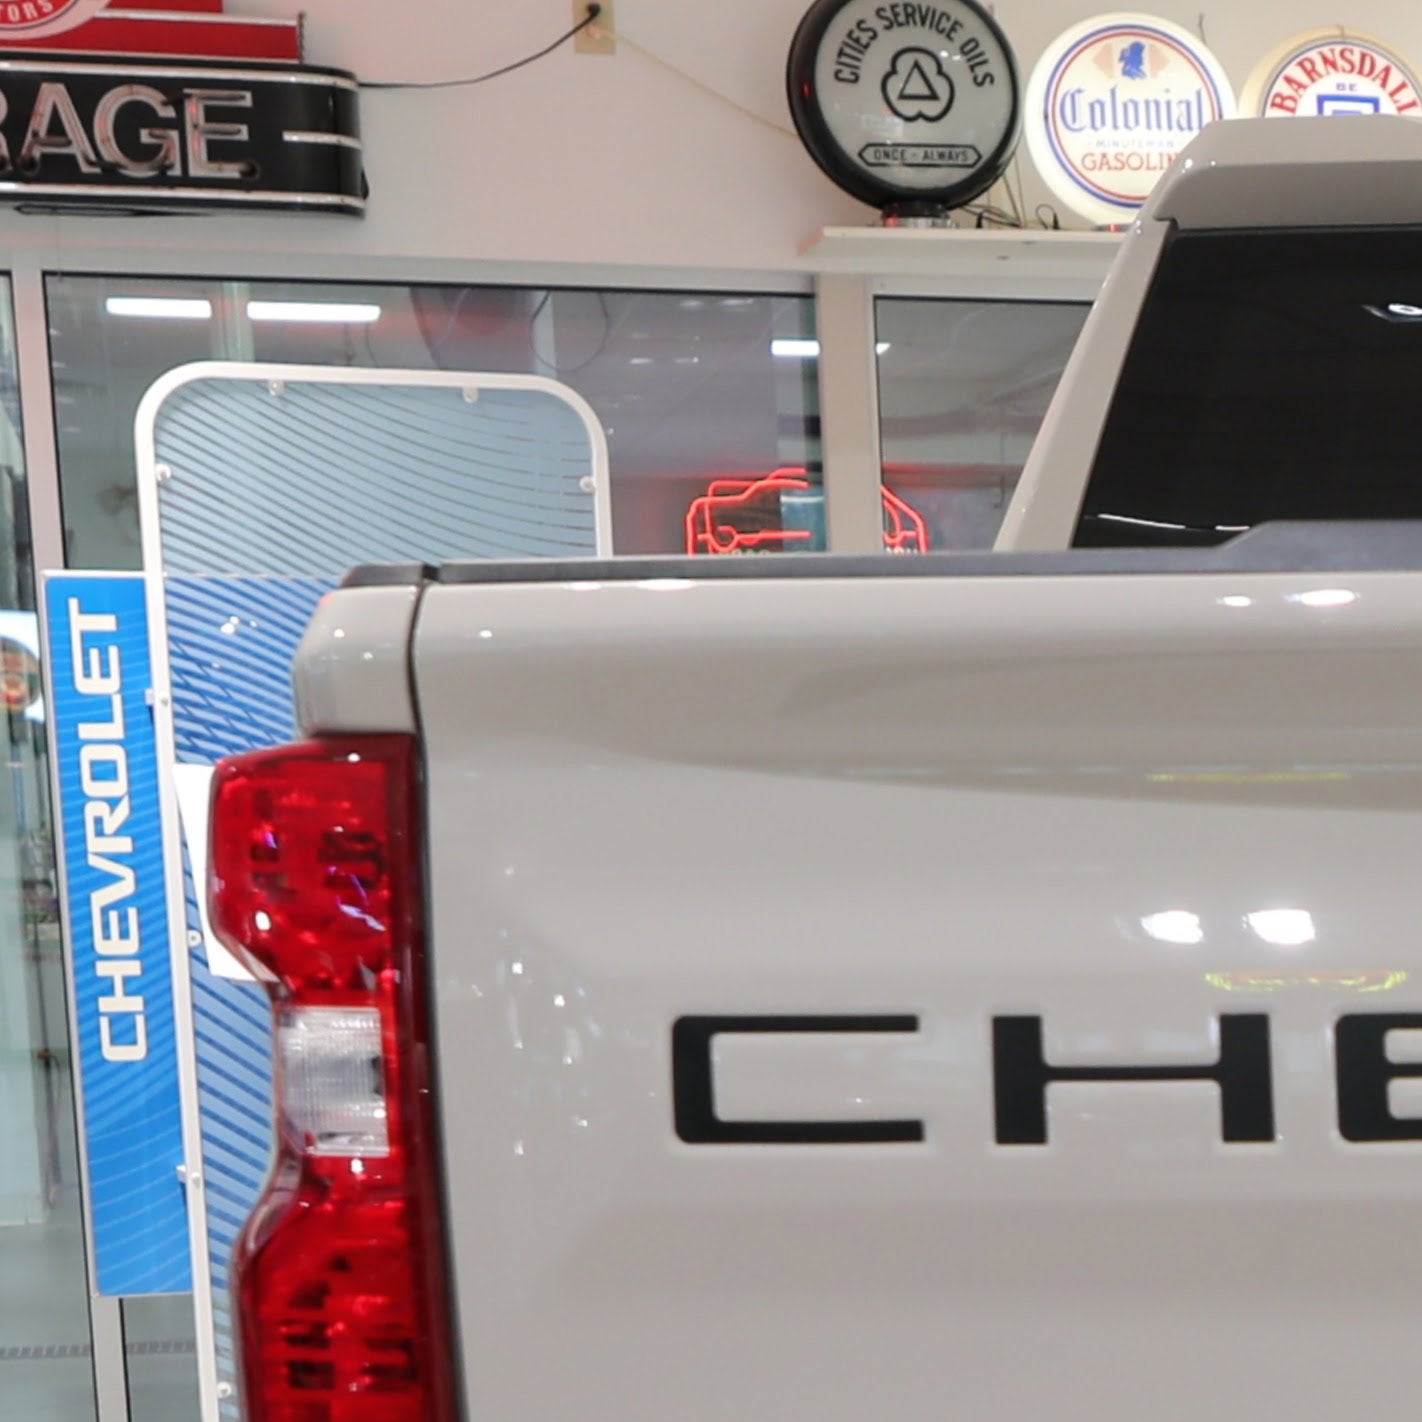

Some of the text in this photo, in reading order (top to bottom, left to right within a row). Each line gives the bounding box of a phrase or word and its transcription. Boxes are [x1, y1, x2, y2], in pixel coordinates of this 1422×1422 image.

[834, 3, 994, 87] CITIES SERVICE OILS
[0, 83, 252, 178] AGE
[1059, 84, 1203, 132] Colonial
[873, 149, 907, 161] ONCE
[68, 597, 147, 1062] CHEVROLET
